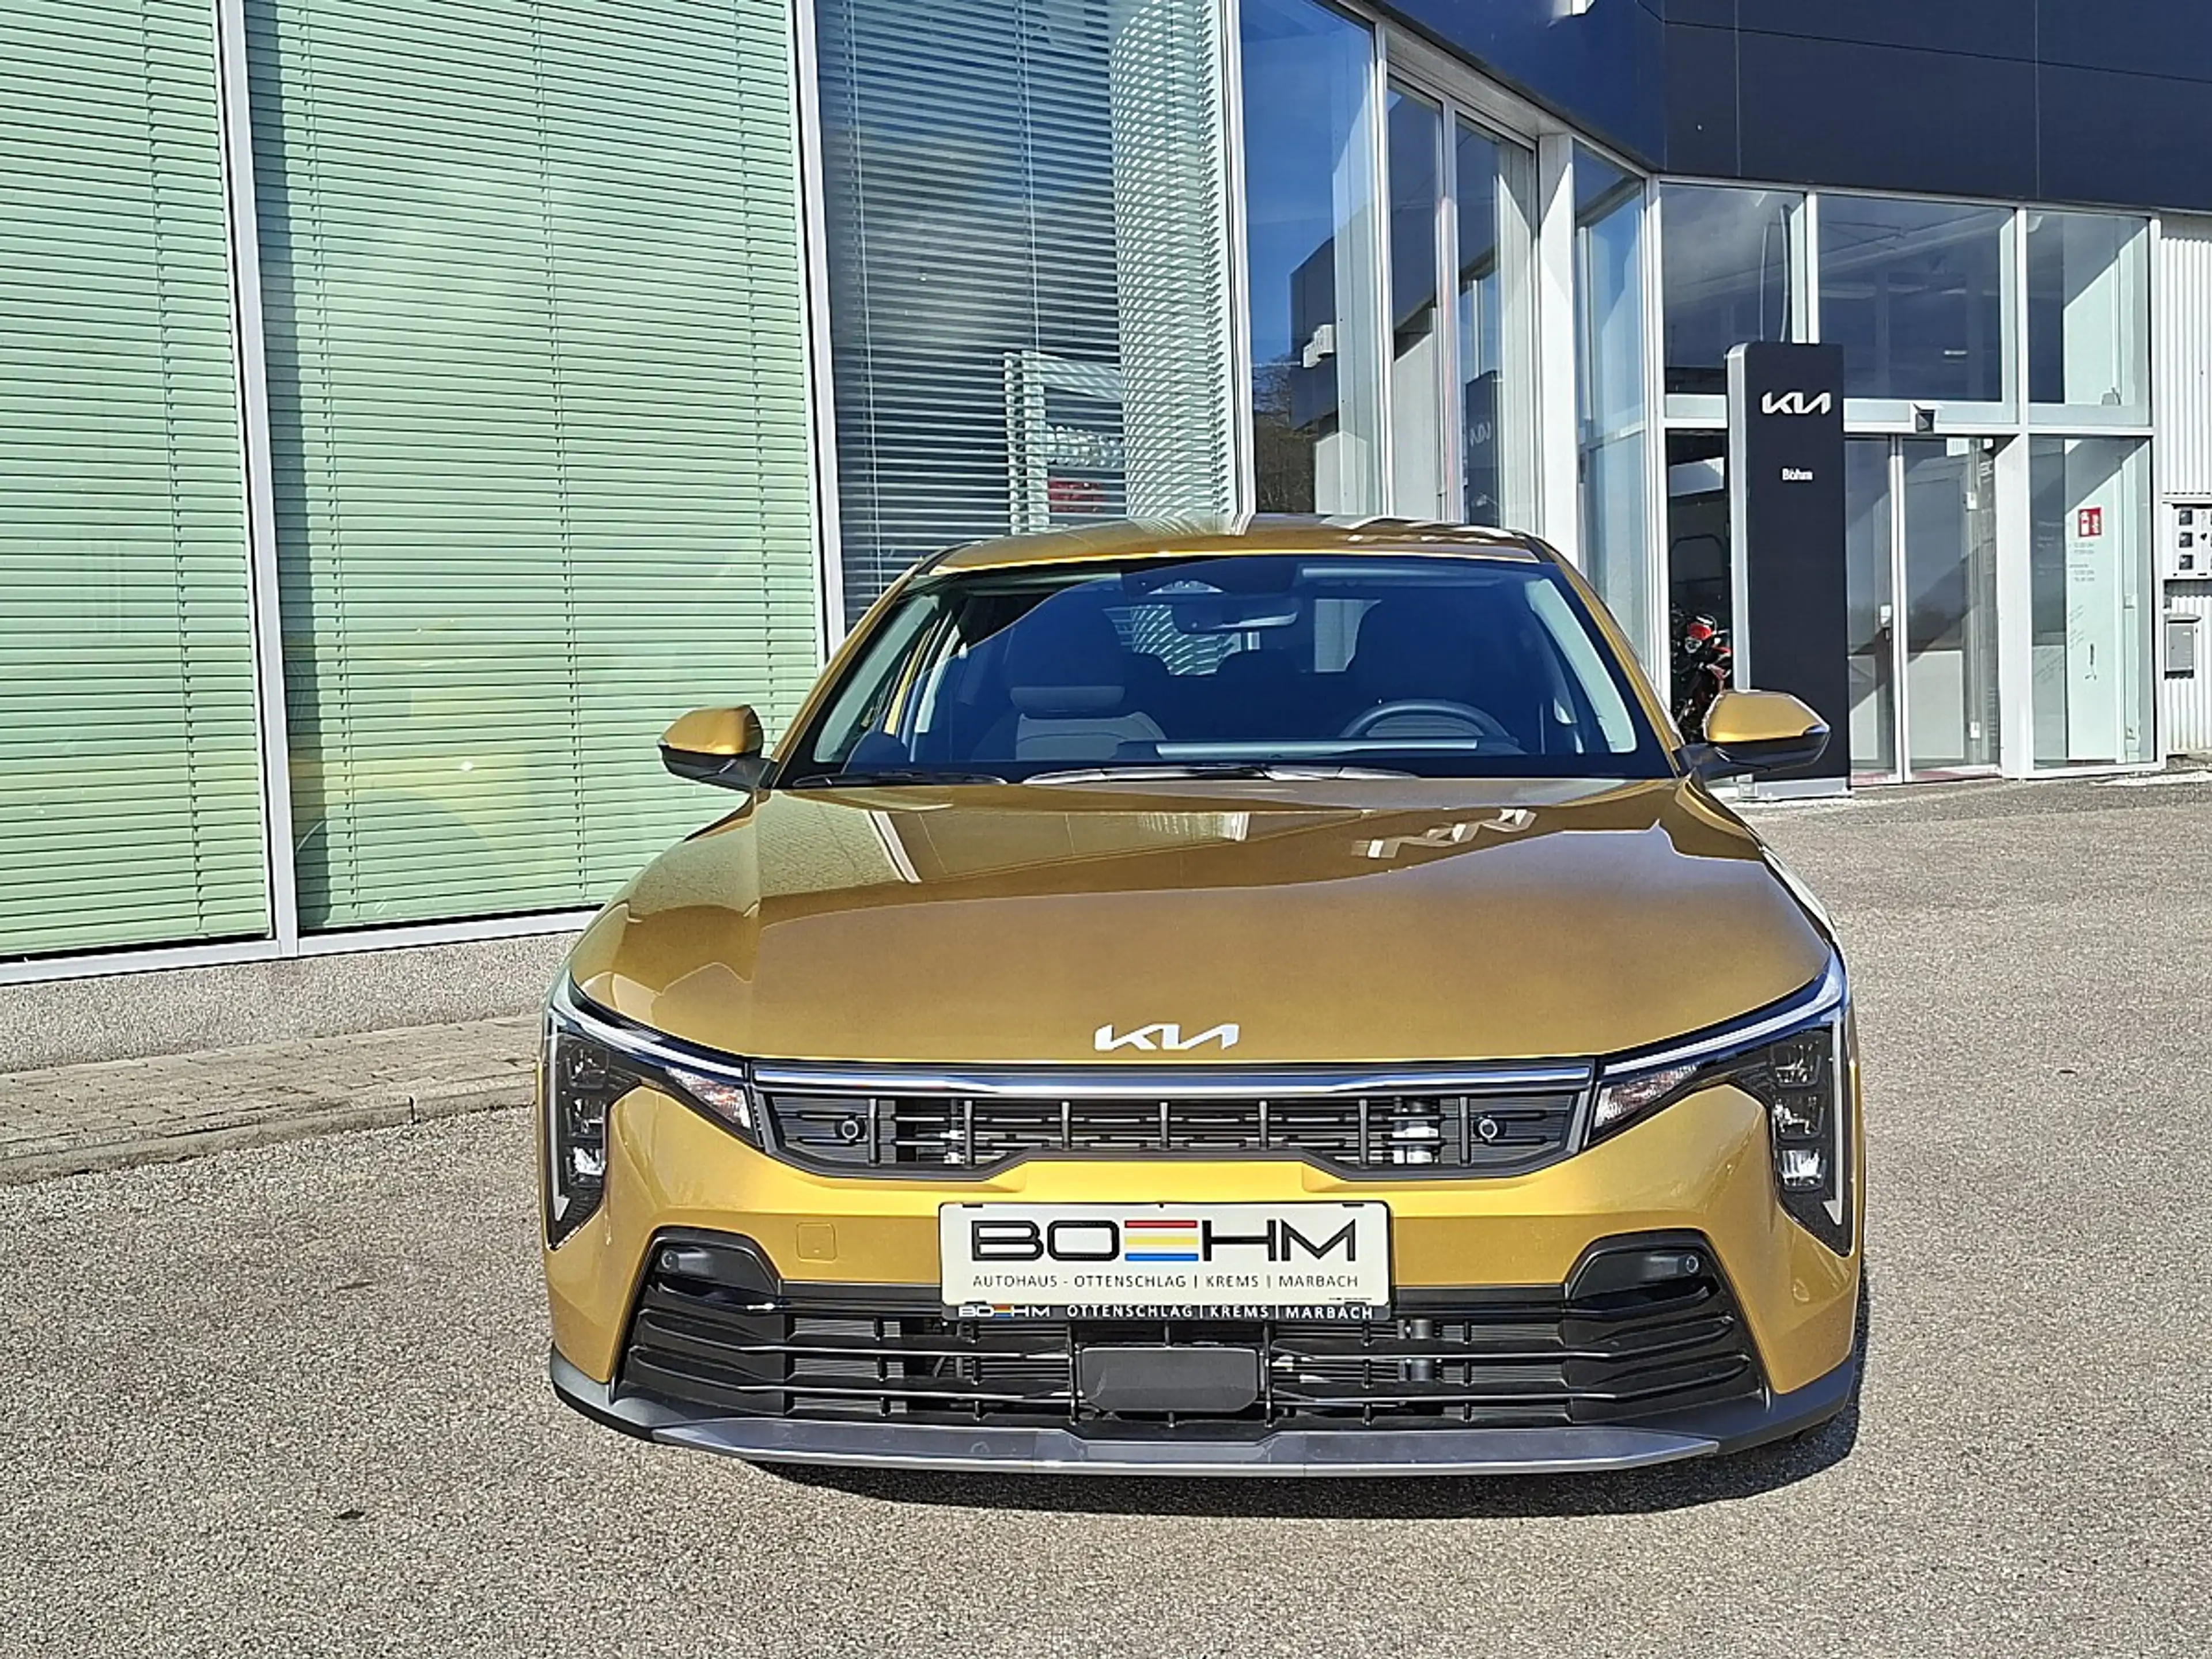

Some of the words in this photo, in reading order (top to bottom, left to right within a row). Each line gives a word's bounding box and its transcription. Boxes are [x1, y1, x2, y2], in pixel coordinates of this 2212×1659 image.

[1762, 392, 1831, 414] KIA
[1782, 468, 1813, 480] Böhm
[1095, 1023, 1239, 1051] KIA
[973, 1275, 1057, 1287] AUTOHAUS
[1074, 1275, 1187, 1287] OTTENSCHLAG
[1206, 1275, 1259, 1287] KREMS
[1279, 1275, 1358, 1287] MARBACH
[1067, 1305, 1192, 1318] OTTENSCHLAG
[1209, 1305, 1268, 1319] KREMS
[1286, 1306, 1373, 1319] MARBACH
